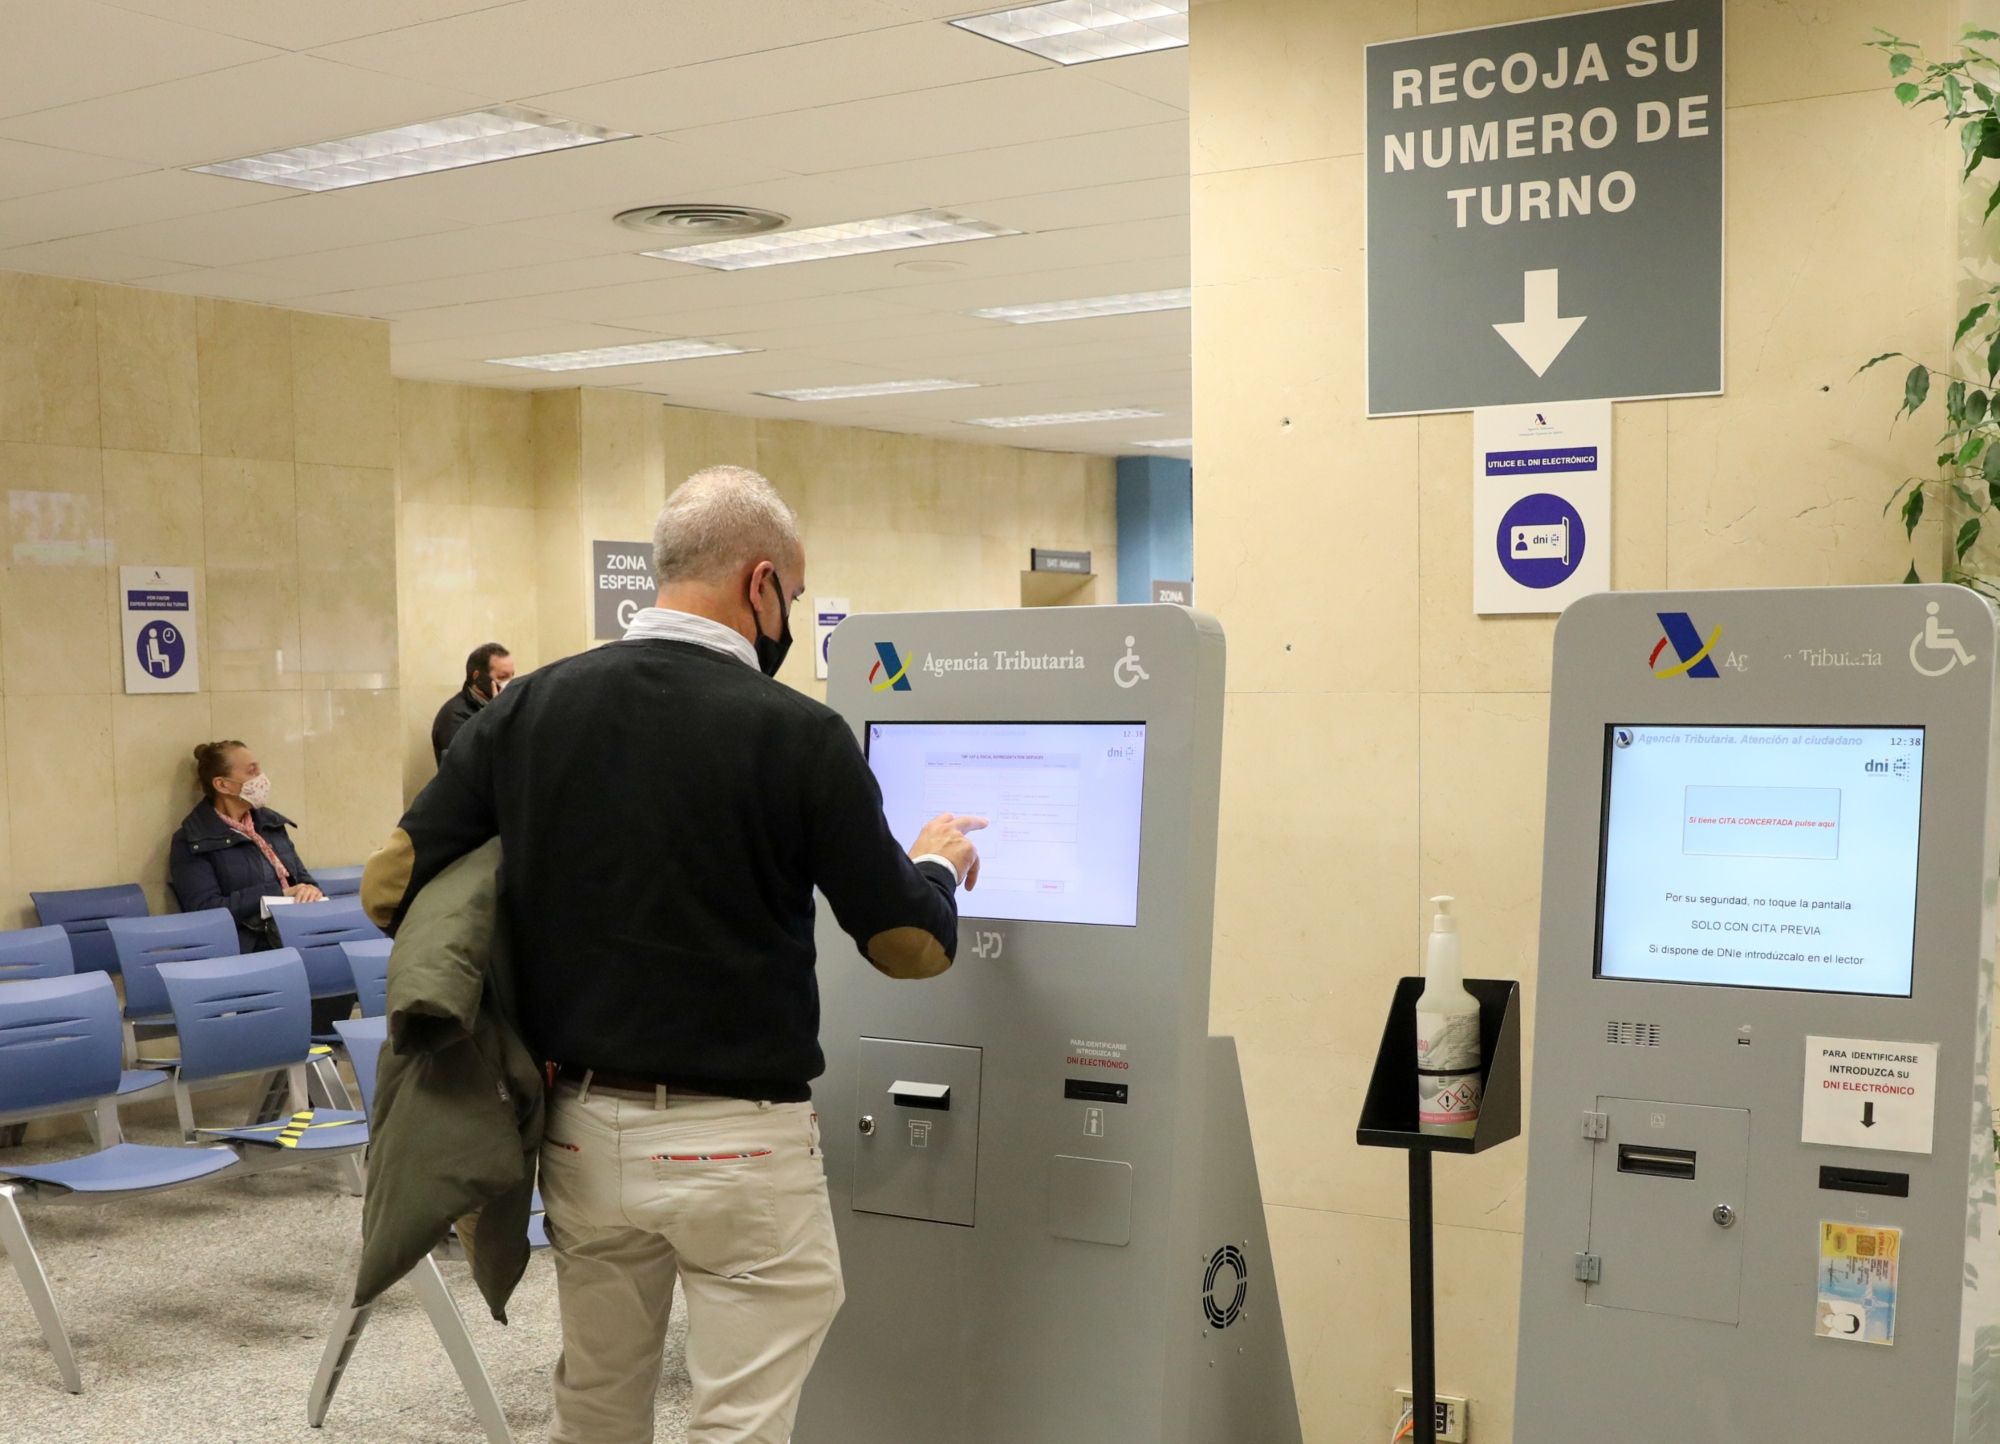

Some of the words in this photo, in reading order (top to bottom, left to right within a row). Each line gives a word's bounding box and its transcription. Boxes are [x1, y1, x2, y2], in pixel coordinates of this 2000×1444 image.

[1392, 42, 1610, 110] RECOJA
[1625, 28, 1698, 79] SU
[1384, 106, 1618, 173] NUMERO
[1636, 95, 1709, 143] DE
[1447, 170, 1636, 228] TURNO
[1488, 460, 1516, 468] UTILICE
[1528, 458, 1540, 466] DNI
[1542, 456, 1595, 466] ELECTRÓNICO
[1532, 534, 1548, 545] dni
[606, 555, 647, 571] ZONA
[599, 575, 655, 591] ESPERA
[1159, 590, 1184, 603] ZONA
[617, 599, 638, 630] G
[922, 651, 989, 678] Agencia
[993, 649, 1086, 671] Tributaria
[1638, 733, 1680, 745] Agencia
[1684, 734, 1736, 744] Tributaria.
[1740, 734, 1789, 746] Atención
[1792, 735, 1801, 745] al
[1804, 735, 1863, 746] ciudadano
[1890, 737, 1921, 746] 12:38
[1106, 746, 1123, 759] dni
[1864, 758, 1889, 773] dni
[1688, 816, 1696, 824] Si
[1718, 817, 1736, 825] CITA
[1738, 818, 1793, 826] CONCERTADA
[1794, 820, 1816, 828] pulse
[1665, 892, 1682, 902] Por
[1685, 895, 1696, 903] su
[1753, 898, 1766, 906] no
[1768, 898, 1796, 908] toque
[1799, 899, 1809, 908] la
[1811, 900, 1852, 910] pantalla
[1691, 920, 1722, 930] SOLO
[1724, 922, 1748, 932] CON
[1752, 923, 1776, 933] CITA
[1780, 924, 1821, 935] PREVIA
[1649, 944, 1659, 953] Si
[1661, 946, 1699, 957] dispone
[1701, 947, 1714, 956] de
[1716, 948, 1742, 958] DNIe
[1744, 950, 1804, 962] introdúzcalo
[1807, 954, 1820, 963] en
[1823, 954, 1832, 963] el
[1835, 954, 1864, 965] lector
[1066, 1056, 1079, 1064] DNI
[1822, 1049, 1847, 1058] PARA
[1851, 1052, 1918, 1064] IDENTIFICARSE
[1830, 1064, 1895, 1078] INTRODUZCA
[1897, 1070, 1910, 1079] SU
[1823, 1080, 1840, 1089] DNI
[1842, 1082, 1915, 1096] ELECTRÓNICO
